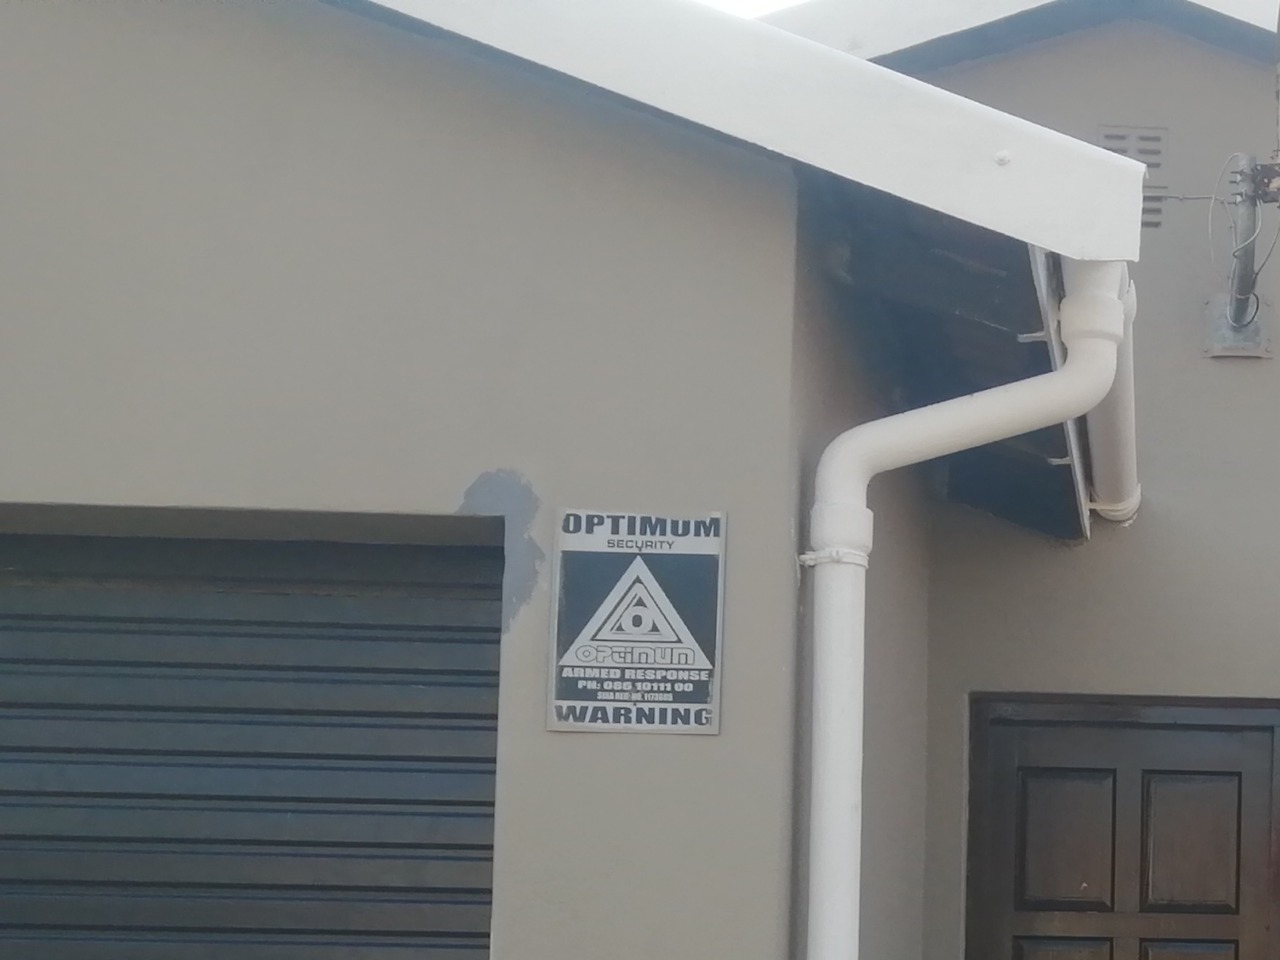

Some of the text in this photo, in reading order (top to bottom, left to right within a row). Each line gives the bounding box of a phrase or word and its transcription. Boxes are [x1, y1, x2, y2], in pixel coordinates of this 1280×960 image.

[562, 513, 721, 538] OPTIMUM
[607, 539, 675, 550] SECURITY
[562, 667, 710, 681] ARMED RESPONSE
[555, 705, 713, 726] WARNING
